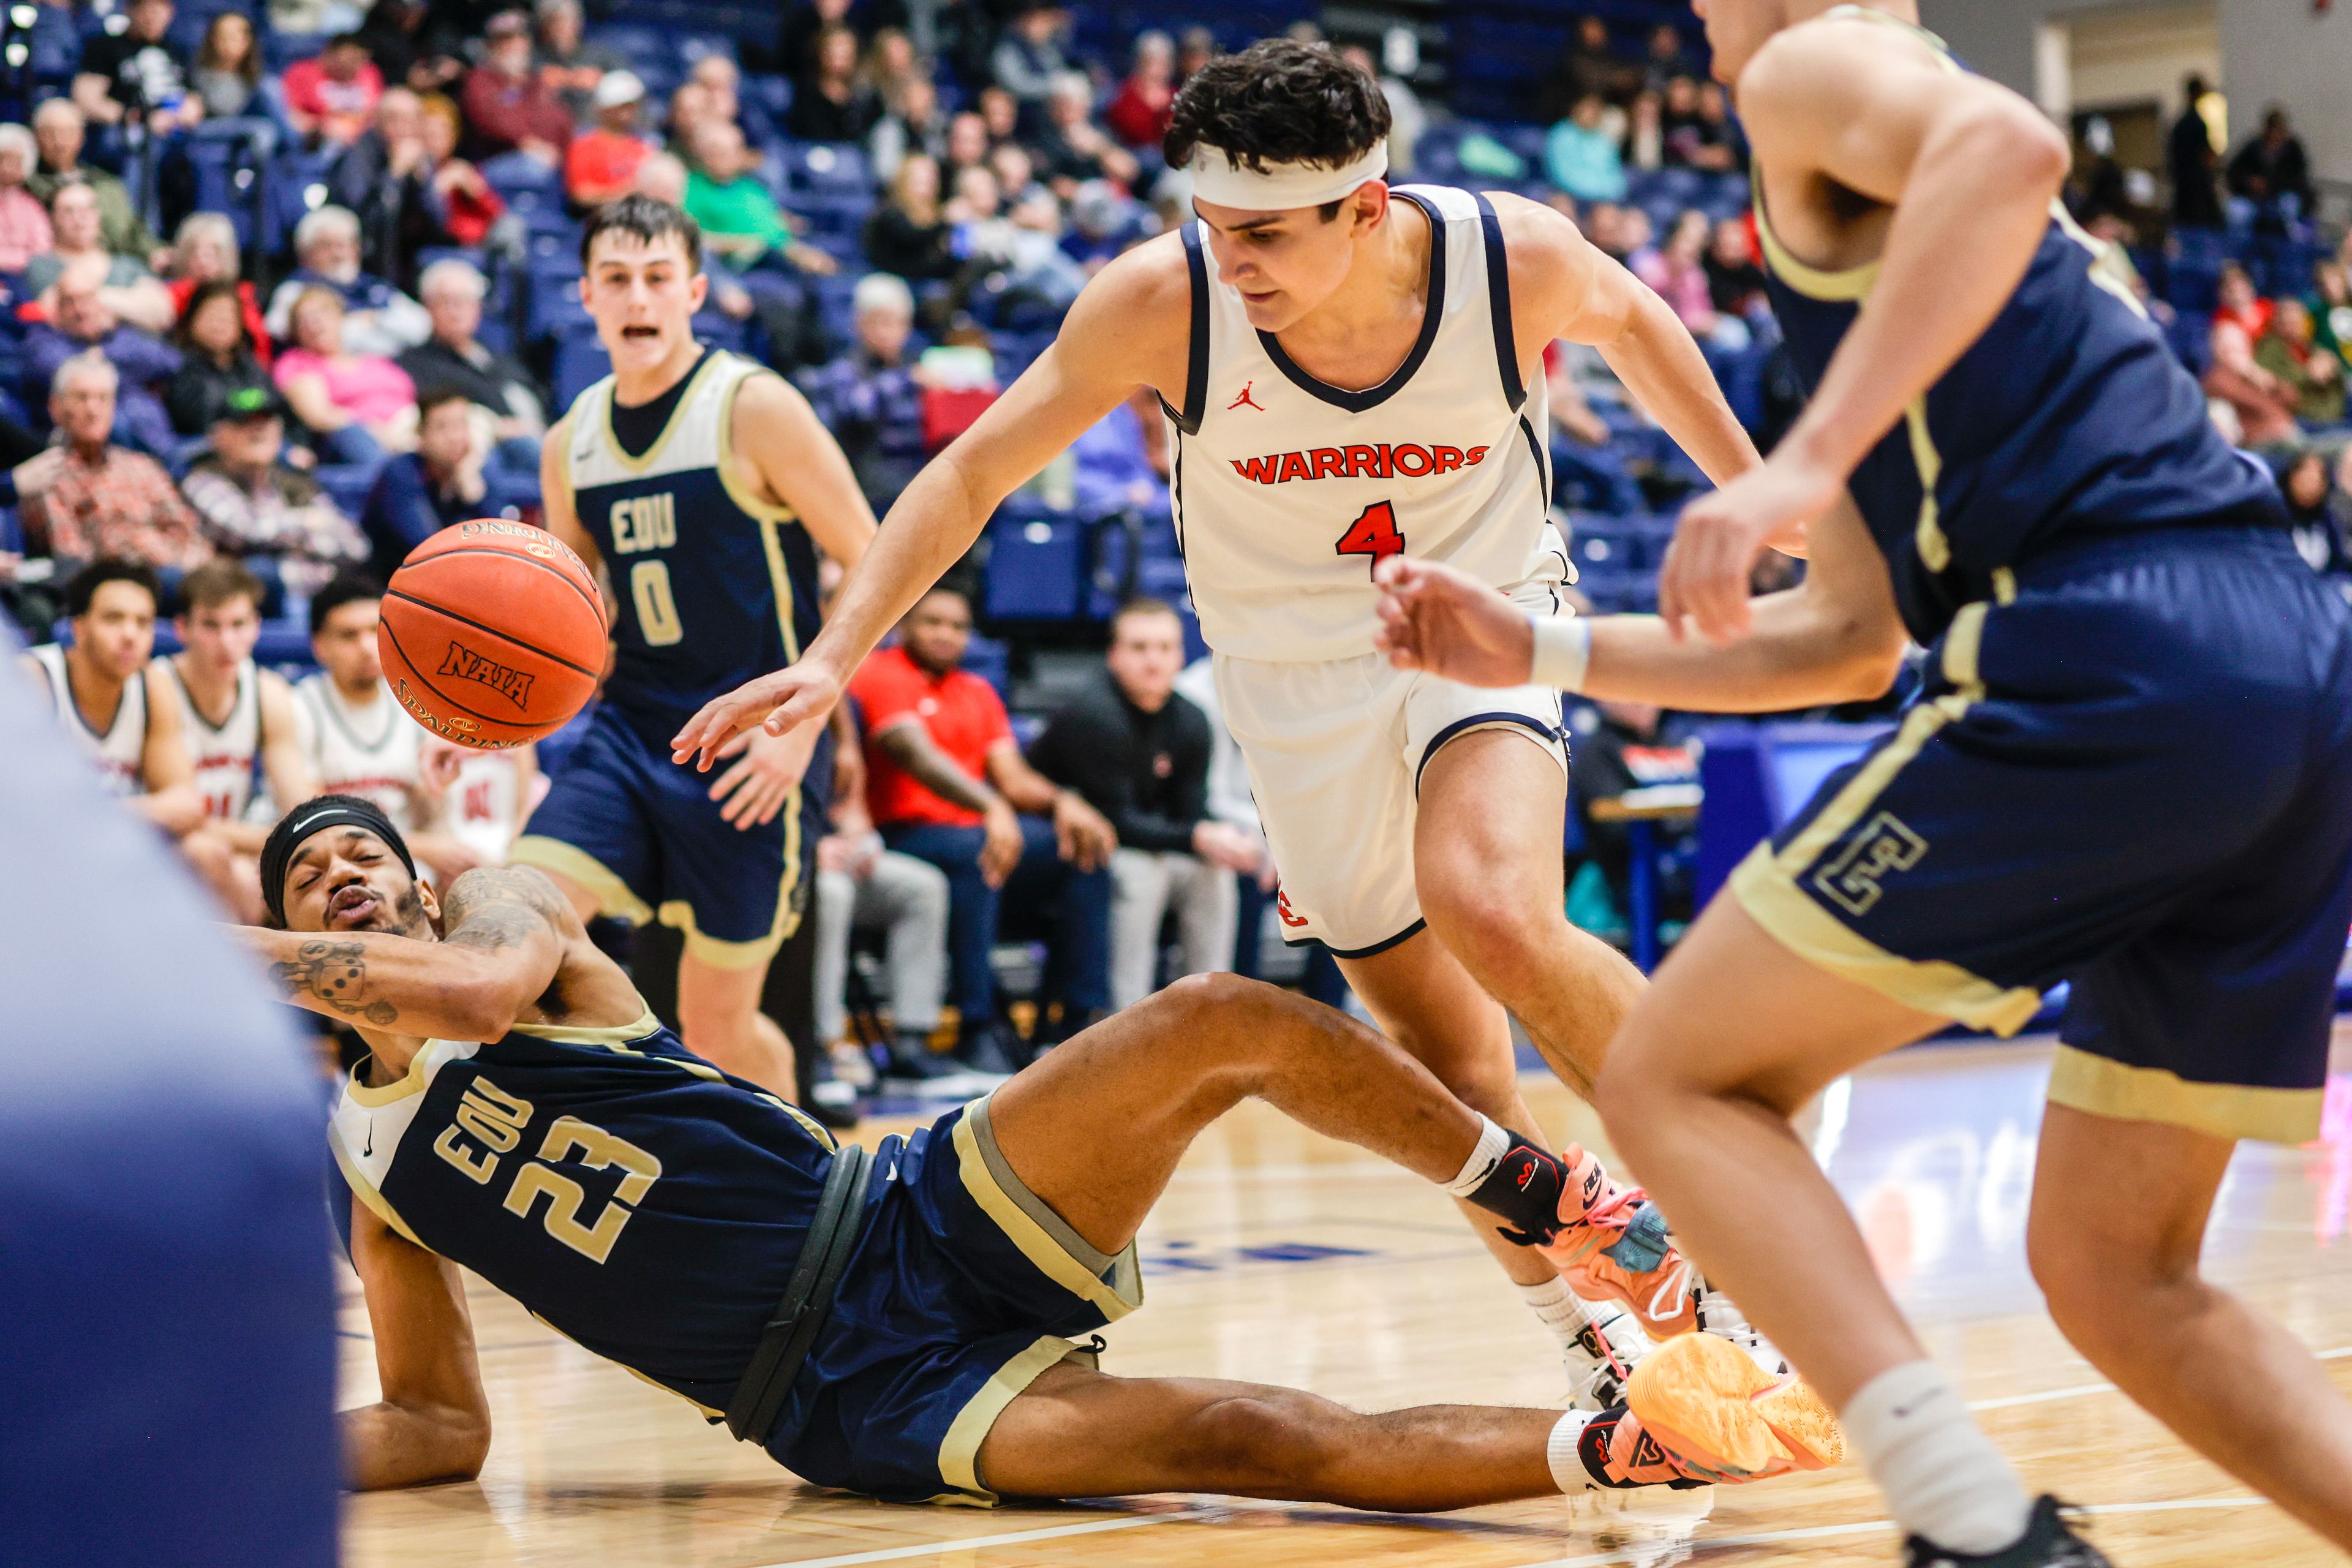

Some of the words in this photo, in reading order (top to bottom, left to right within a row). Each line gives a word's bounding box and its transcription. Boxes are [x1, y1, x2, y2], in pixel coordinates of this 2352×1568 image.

[1227, 443, 1491, 484] WARRIORS
[1335, 499, 1406, 583] 4
[630, 559, 684, 647] 0
[437, 640, 535, 710] NAIA
[433, 1075, 534, 1185] EOU
[502, 1115, 663, 1265] 23
